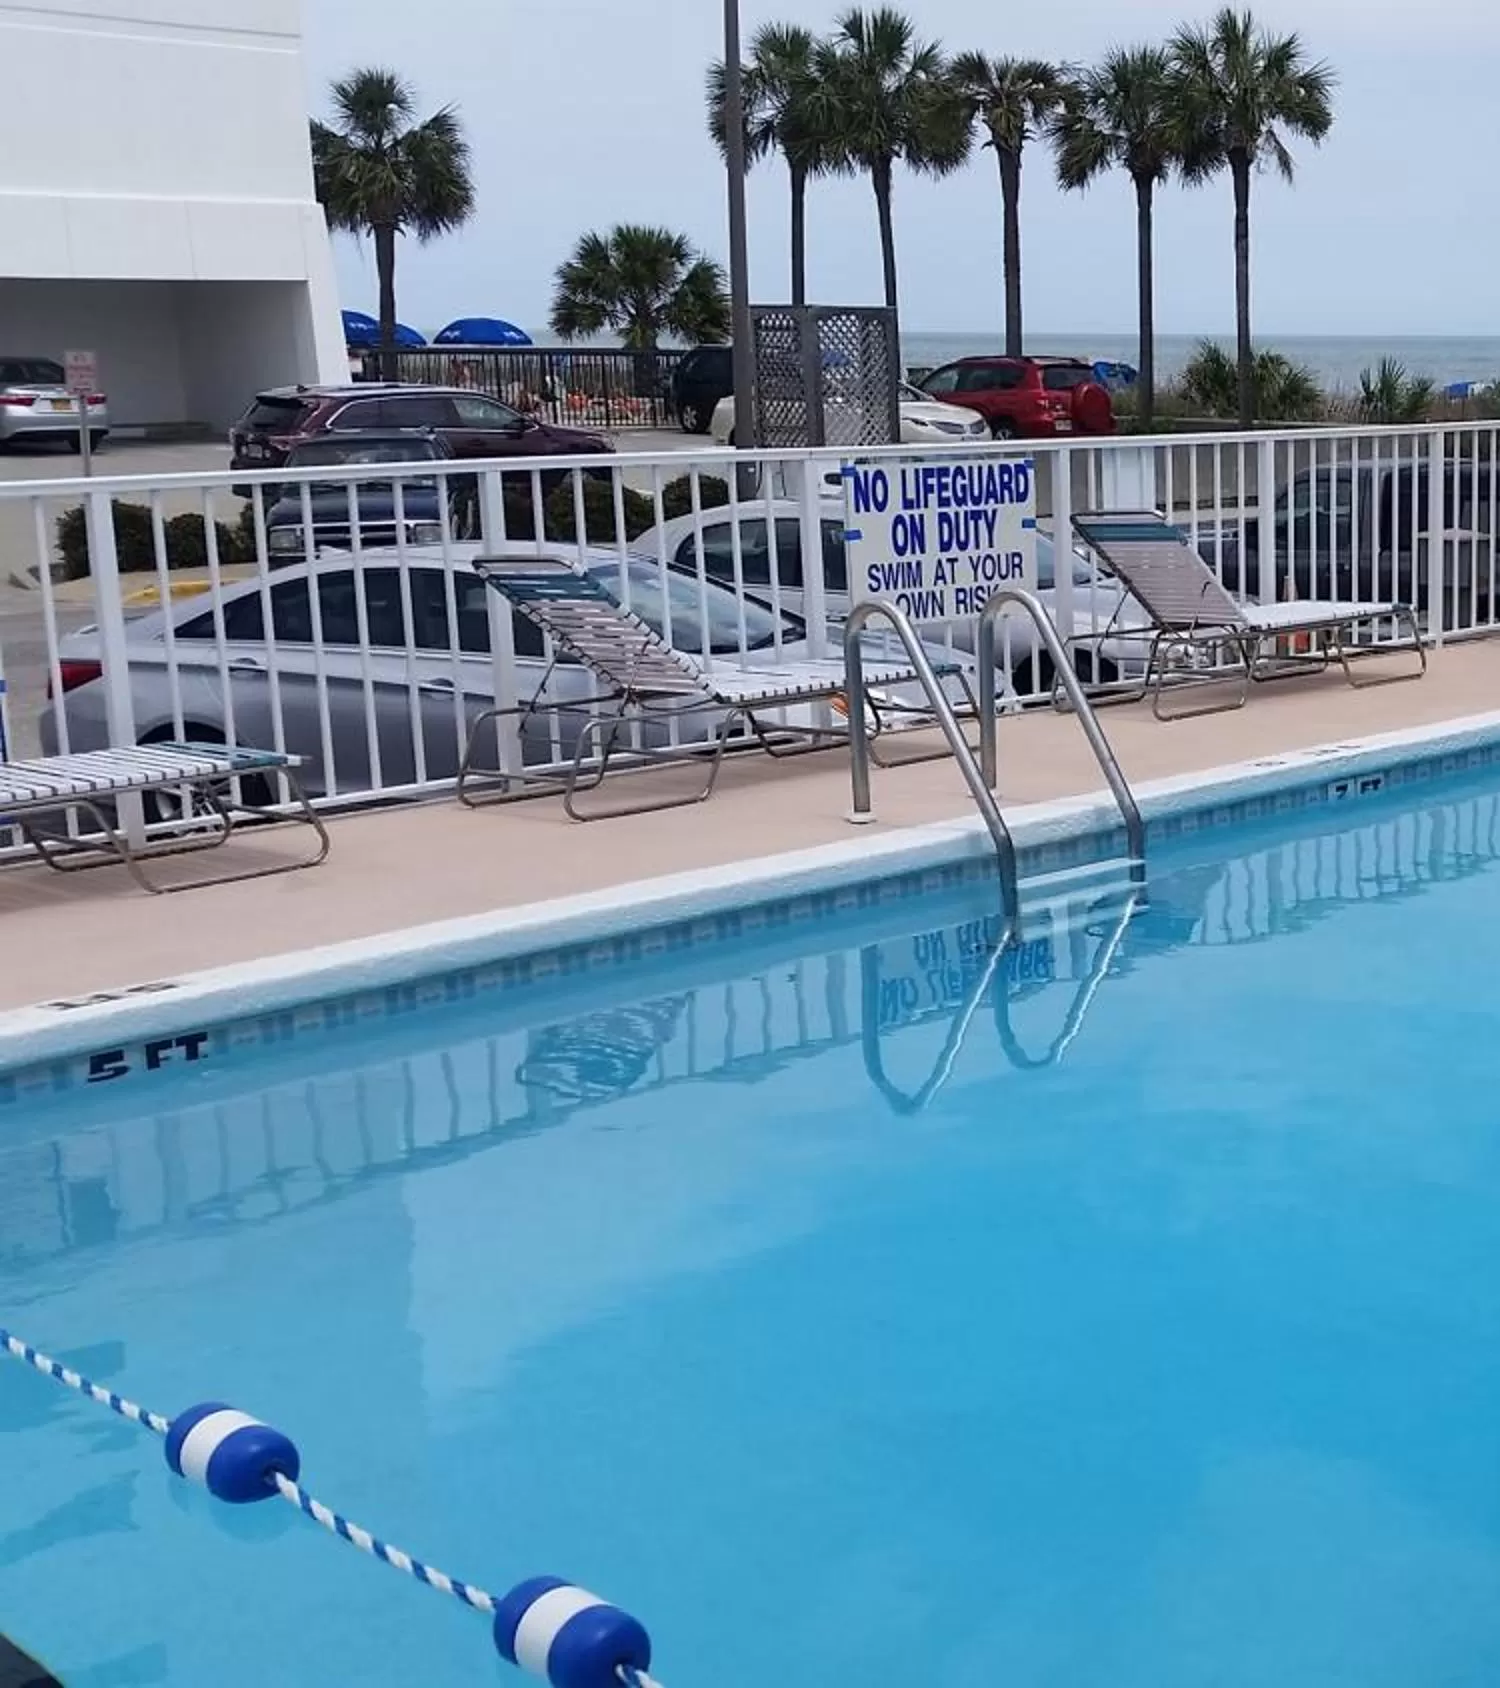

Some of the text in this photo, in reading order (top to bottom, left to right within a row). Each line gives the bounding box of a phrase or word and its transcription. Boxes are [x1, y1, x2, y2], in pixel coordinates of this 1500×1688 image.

[853, 464, 1029, 513] NO LIFEGUARD
[891, 509, 997, 557] ON DUTY
[867, 552, 1024, 593] SWIM AT YOUR
[1335, 777, 1382, 800] 7 FT
[86, 1031, 209, 1083] 5 FT
